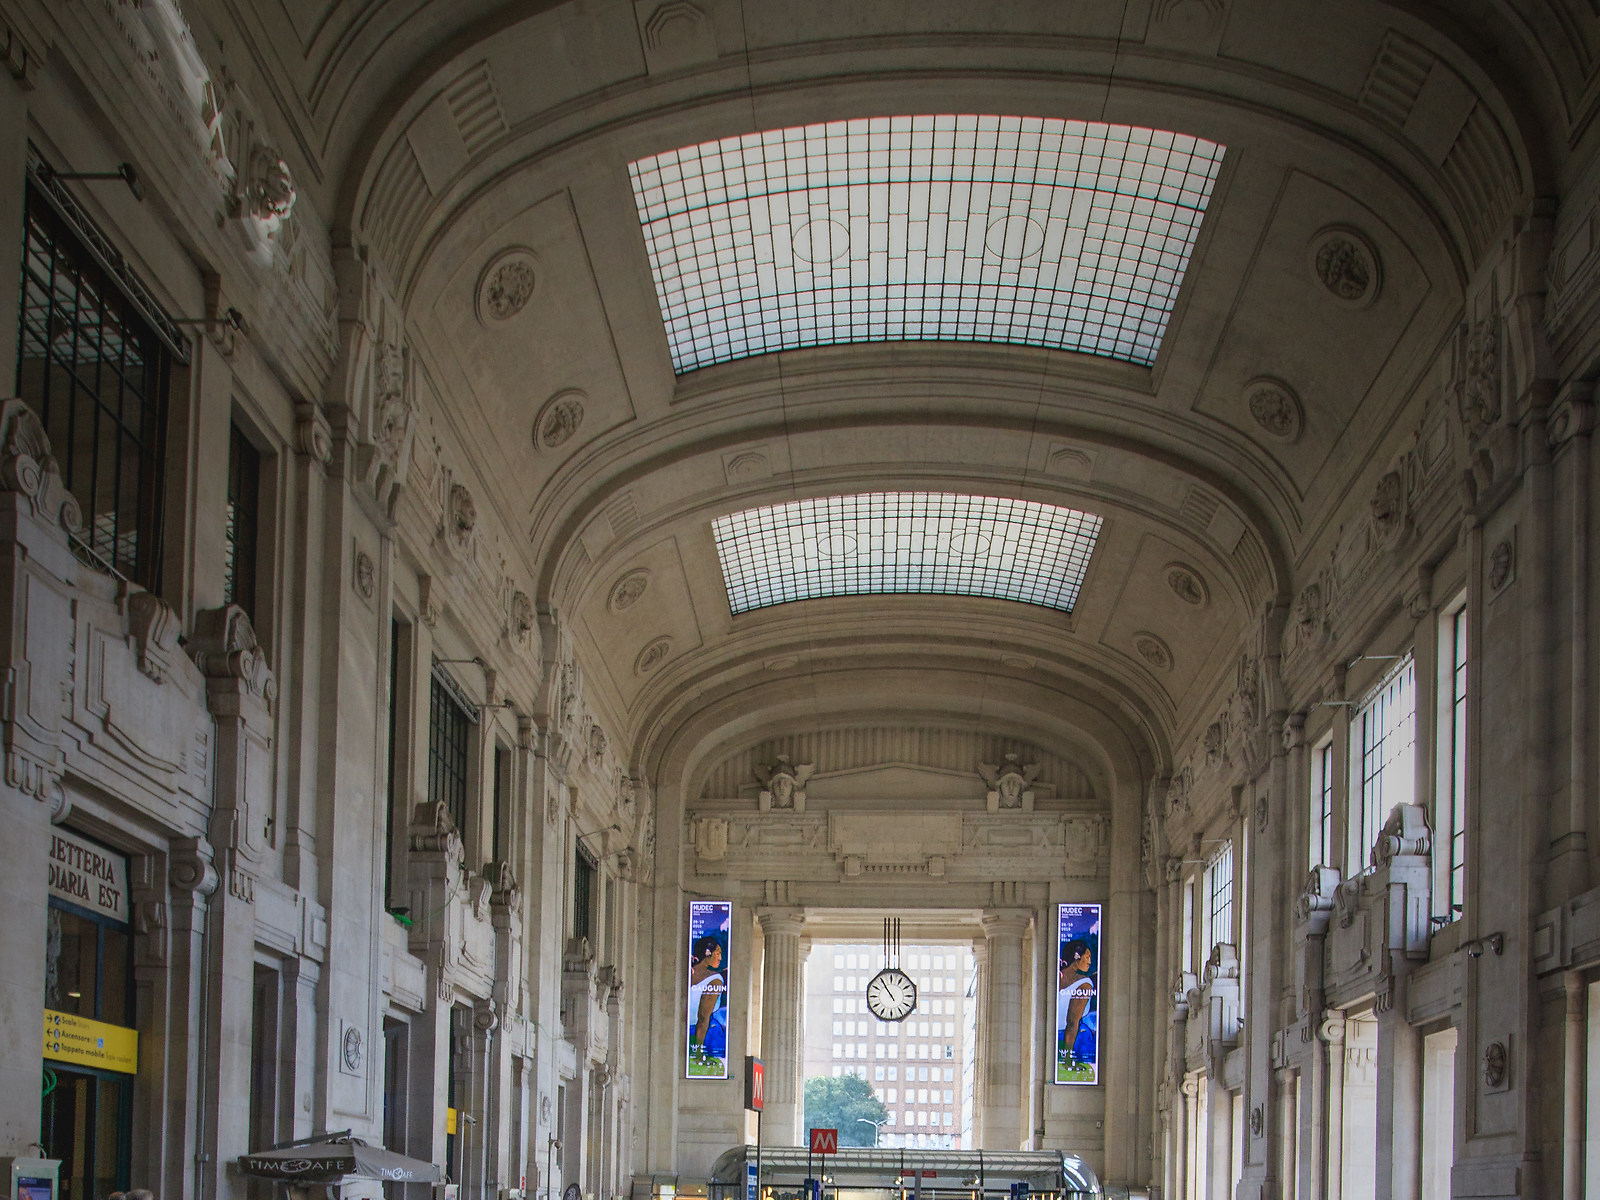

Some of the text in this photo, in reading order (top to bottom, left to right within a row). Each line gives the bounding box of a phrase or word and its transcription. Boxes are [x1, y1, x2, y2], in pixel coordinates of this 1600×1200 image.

[50, 834, 115, 884] IETTERIA
[98, 882, 120, 912] EST
[62, 1016, 76, 1026] Scale
[61, 1030, 90, 1042] Ascensore
[61, 1043, 84, 1054] Tappeto
[86, 1049, 104, 1058] mobile
[753, 1071, 763, 1101] M
[813, 1132, 836, 1150] M
